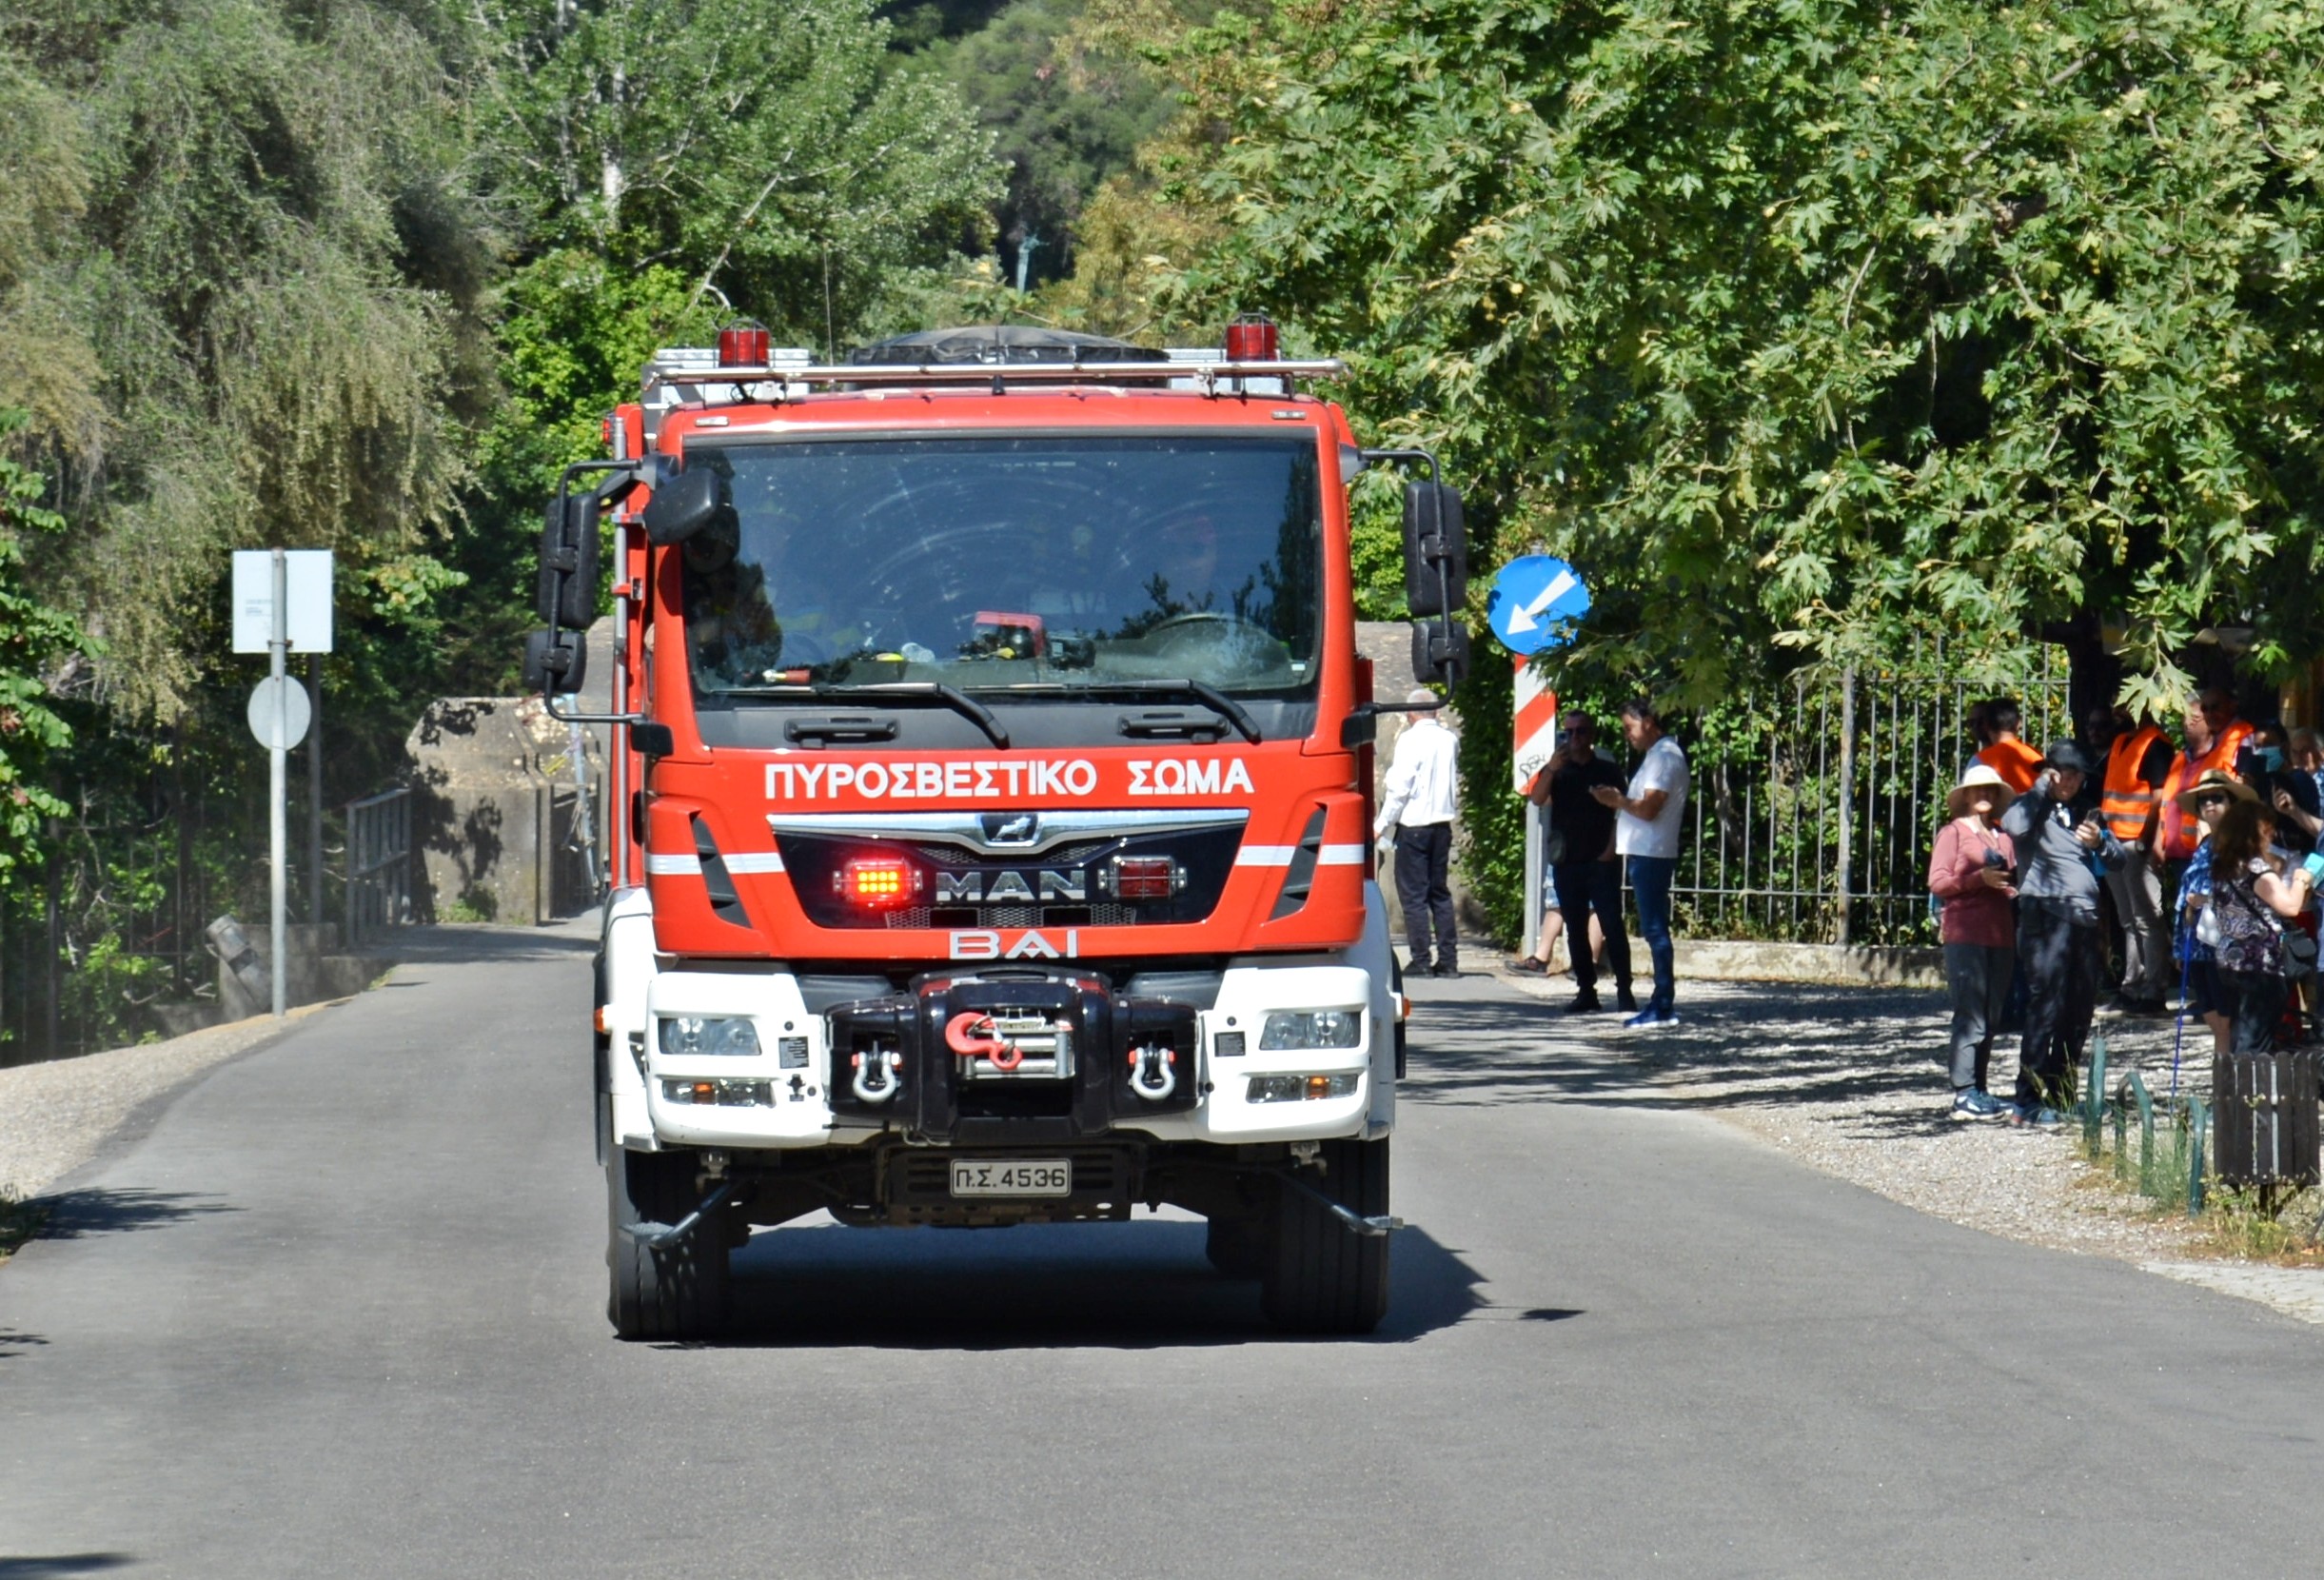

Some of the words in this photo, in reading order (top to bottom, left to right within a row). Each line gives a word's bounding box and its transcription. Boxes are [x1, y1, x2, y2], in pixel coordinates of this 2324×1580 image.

[764, 759, 1097, 800] ΠΥΡΟΣΒΕΣΤΙΚΟ
[1127, 758, 1255, 796] ΣΩΜΑ
[936, 870, 1086, 901] MAN
[949, 929, 1077, 959] BAI
